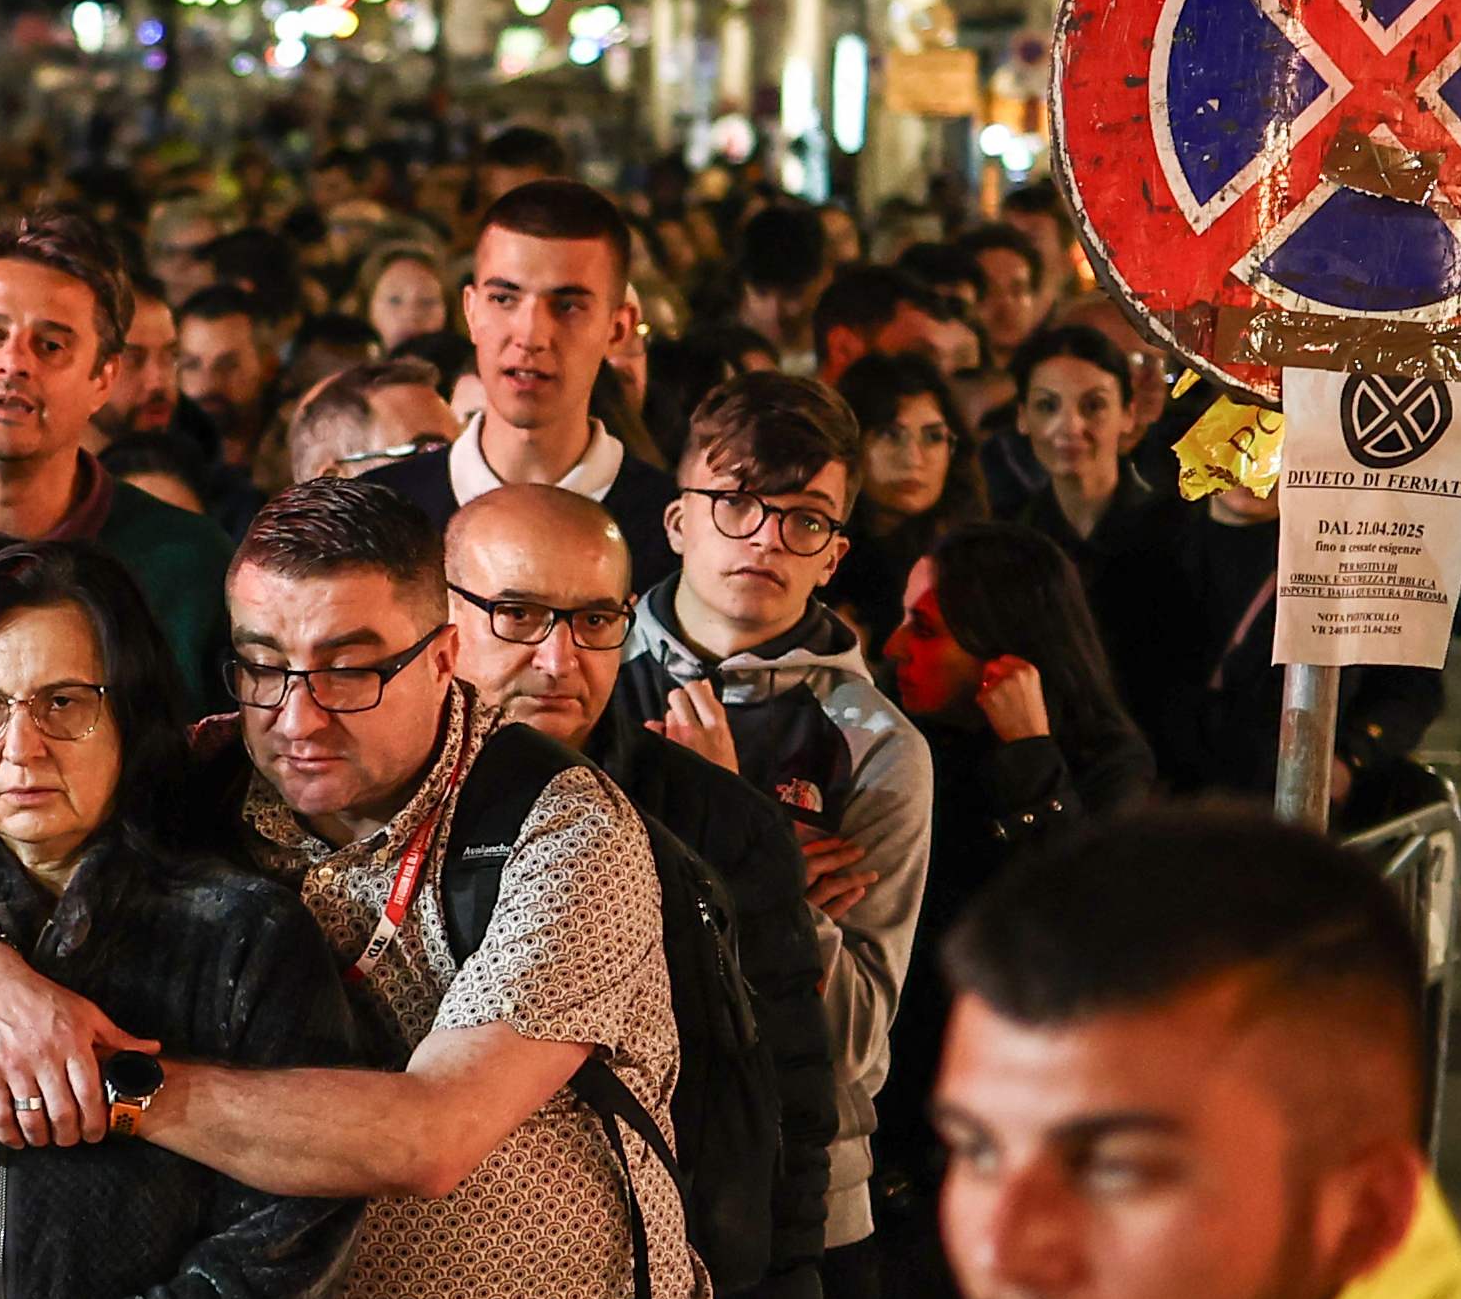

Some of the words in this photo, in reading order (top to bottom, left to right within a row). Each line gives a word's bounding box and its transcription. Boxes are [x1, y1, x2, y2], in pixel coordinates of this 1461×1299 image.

[1287, 469, 1355, 486] DIVIETO
[1362, 472, 1379, 487] DI
[1318, 519, 1353, 536] DAL
[1355, 521, 1425, 539] 21.04.2025
[1315, 540, 1337, 553] fino
[1378, 542, 1422, 556] esigenze
[1290, 573, 1331, 584] ORDINE
[1386, 575, 1436, 590] PUBBLICA
[1416, 589, 1448, 603] ROMA
[1318, 612, 1345, 622] NOTA
